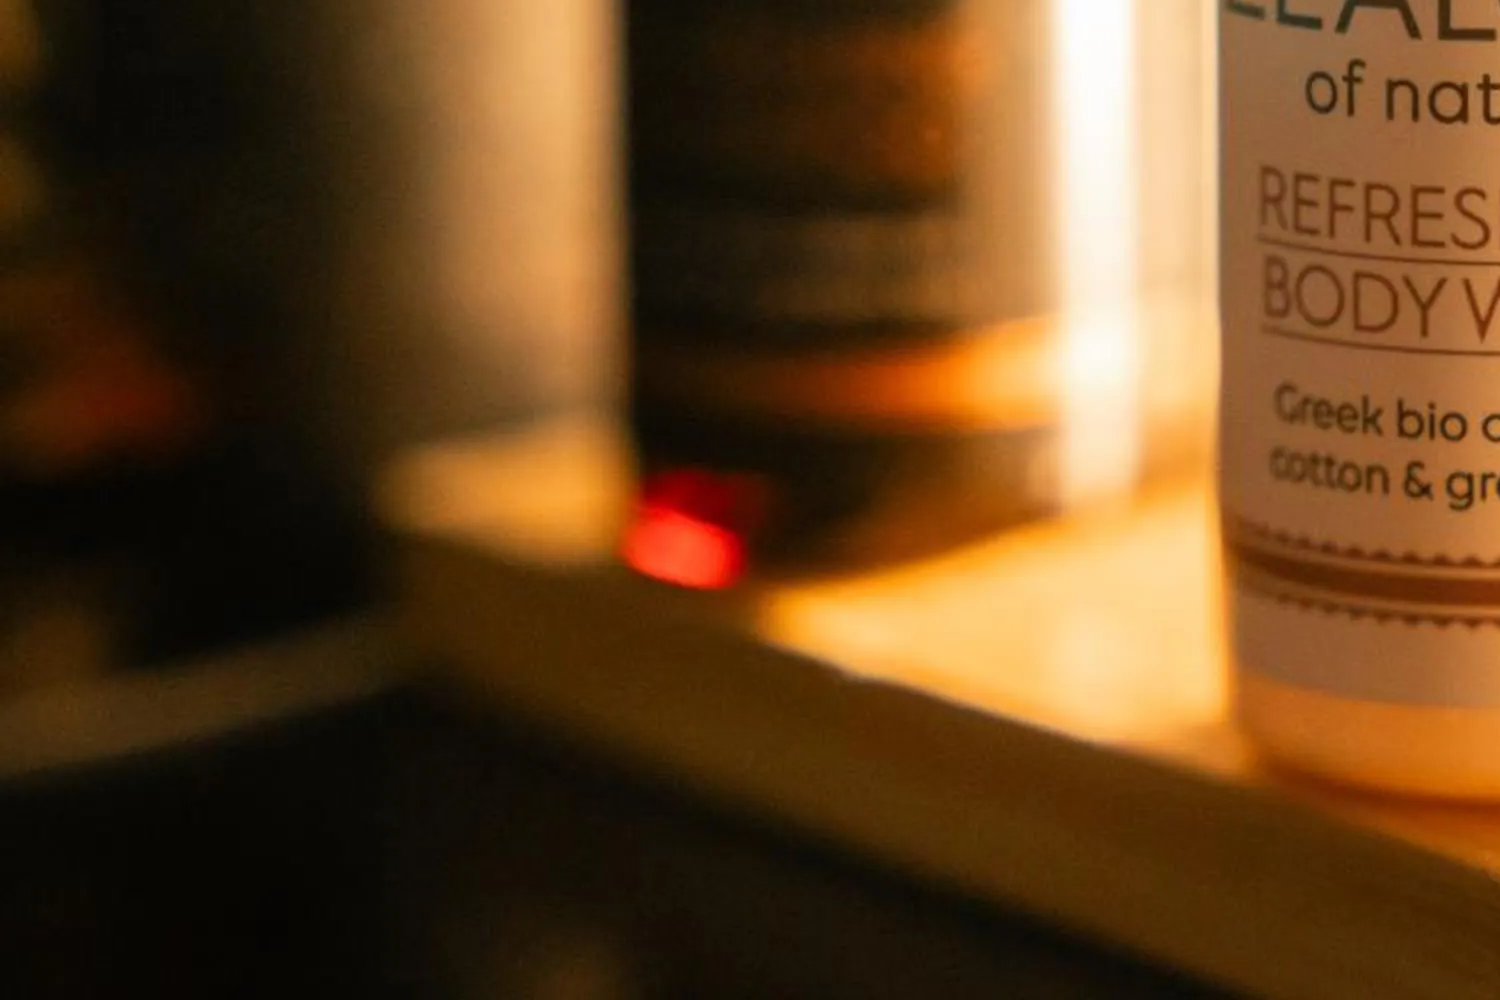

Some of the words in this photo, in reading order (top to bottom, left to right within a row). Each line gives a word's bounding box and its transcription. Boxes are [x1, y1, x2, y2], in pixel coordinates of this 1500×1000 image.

[1304, 58, 1367, 118] of
[1263, 254, 1449, 340] BODY
[1272, 381, 1384, 437] Greek
[1397, 397, 1468, 441] bio
[1269, 444, 1390, 496] cotton
[1402, 460, 1435, 500] &
